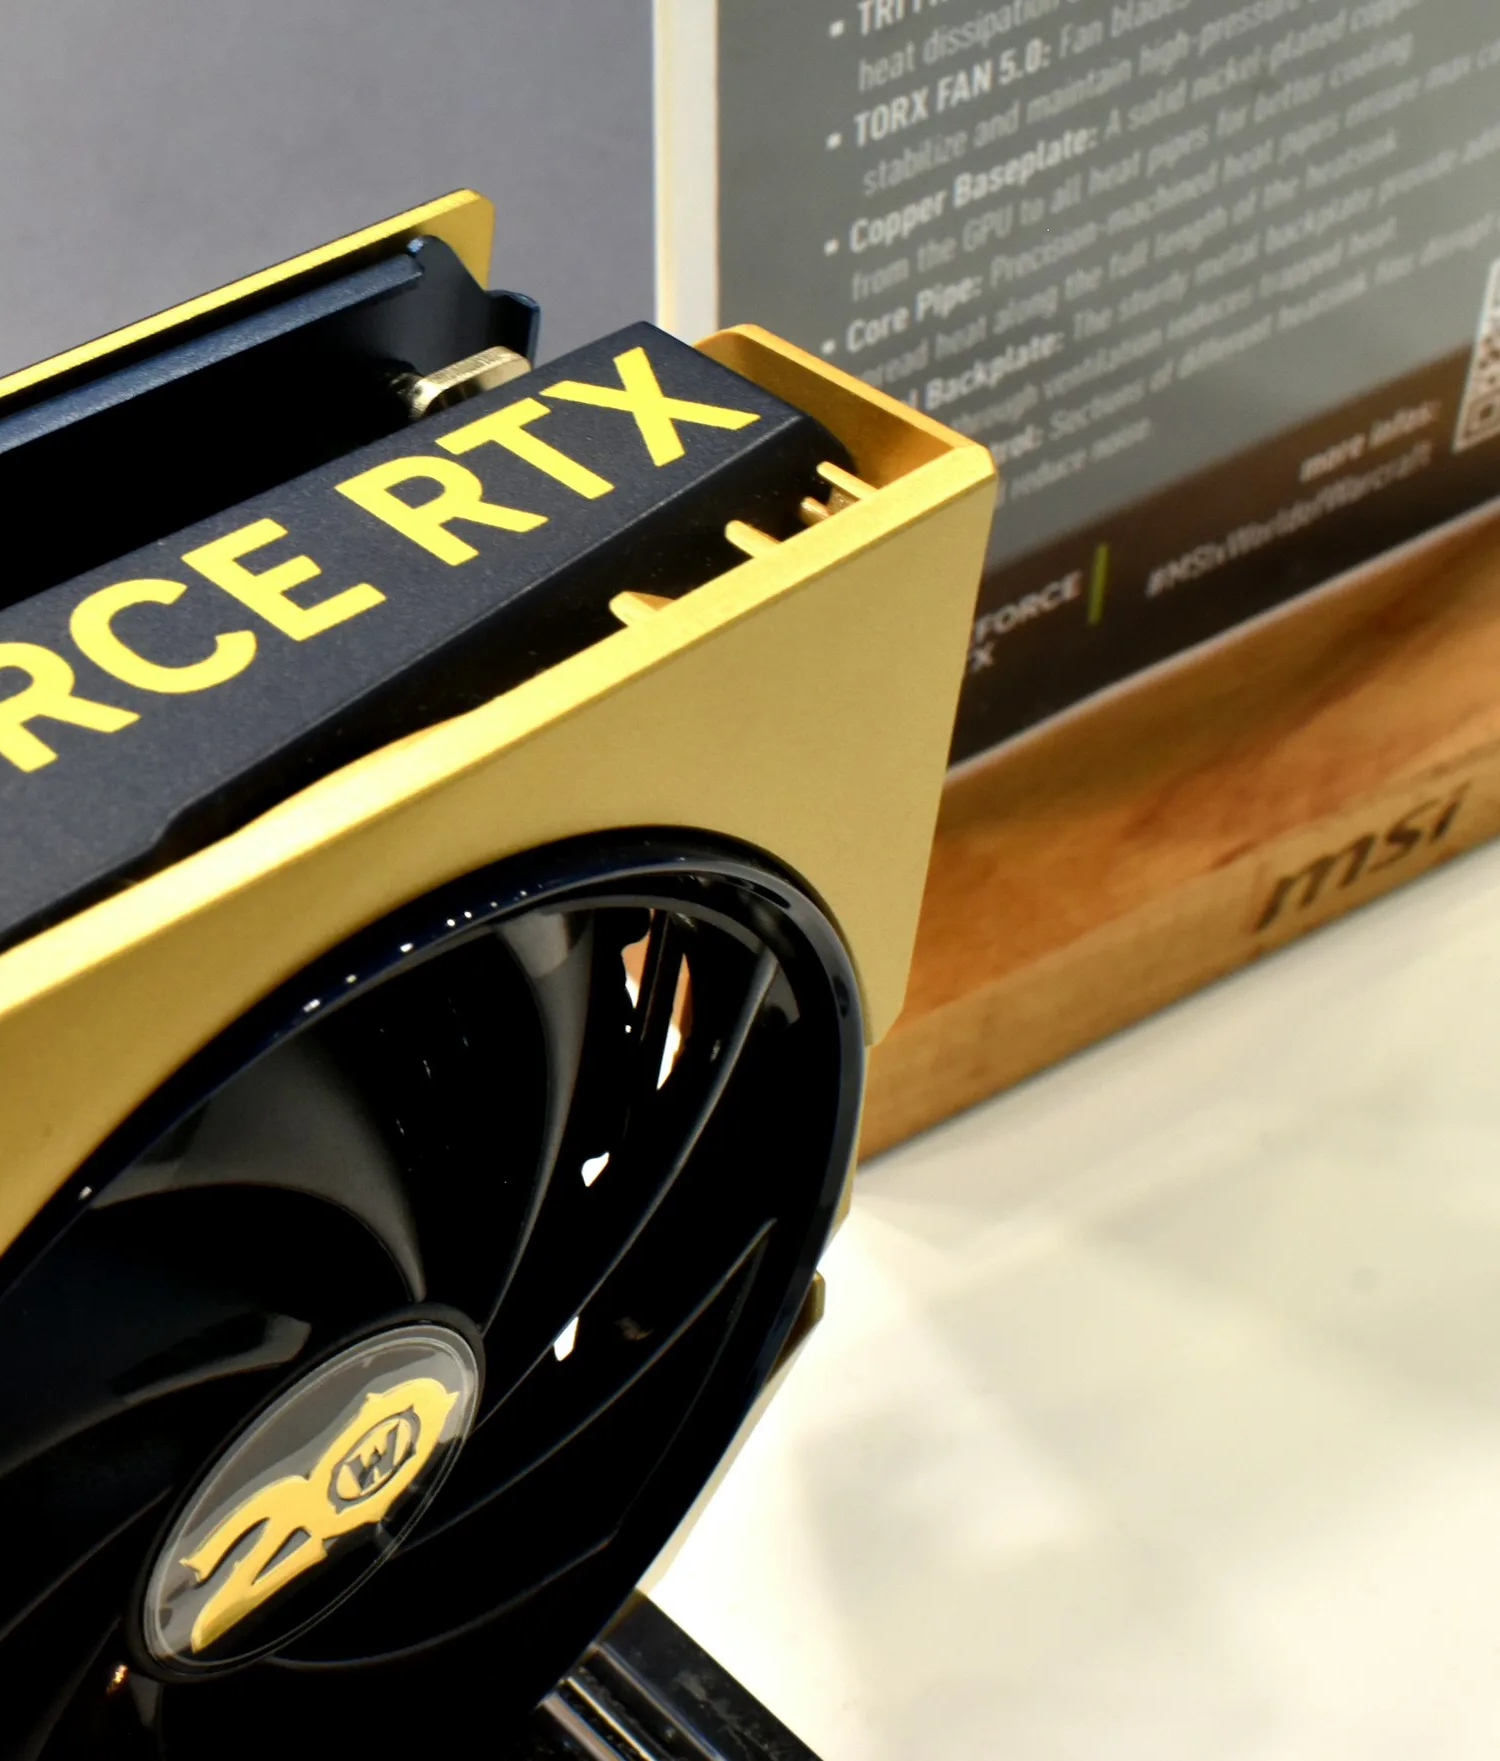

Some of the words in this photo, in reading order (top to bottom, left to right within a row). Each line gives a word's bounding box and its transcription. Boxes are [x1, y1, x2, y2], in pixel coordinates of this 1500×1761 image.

[850, 190, 947, 253] Copper
[954, 126, 1098, 208] Baseplate:
[1104, 107, 1122, 141] A
[1128, 78, 1187, 131] solid
[1192, 5, 1346, 104] nickel-plated
[854, 86, 929, 147] TORX
[936, 59, 992, 113] FAN
[1000, 38, 1051, 85] 5.0:
[1060, 20, 1103, 59] Fan
[859, 41, 915, 92] heat
[863, 131, 968, 196] stabilize
[973, 100, 1020, 148] and
[1026, 58, 1132, 124] maintain
[847, 305, 909, 352] Core
[915, 274, 982, 322] Pipe:
[990, 158, 1220, 290] Precision-machined
[1223, 136, 1274, 184] heat
[1277, 110, 1340, 166] pipes
[853, 257, 909, 302] from
[917, 236, 957, 273] the
[963, 203, 1013, 252] GPU
[1019, 197, 1045, 226] to
[1050, 171, 1082, 215] all
[1088, 149, 1141, 197] heat
[1147, 122, 1209, 178] pipes
[1216, 104, 1247, 140] for
[1254, 71, 1326, 124] better
[926, 331, 1065, 411] Backplate:
[1072, 306, 1113, 342] The
[1117, 267, 1190, 323] sturdy
[1194, 231, 1259, 288] metal
[934, 314, 987, 361] heat
[993, 286, 1059, 336] along
[1064, 265, 1103, 301] the
[1109, 238, 1148, 279] full
[1153, 204, 1228, 263] length
[1232, 186, 1258, 225] of
[1262, 176, 1300, 212] the
[334, 346, 760, 566] RTX
[1050, 379, 1145, 440] Sections
[1149, 357, 1174, 394] of
[1299, 433, 1366, 482] more
[1010, 448, 1087, 500] reduce
[974, 569, 1084, 644] FORCE
[1252, 778, 1472, 934] msi
